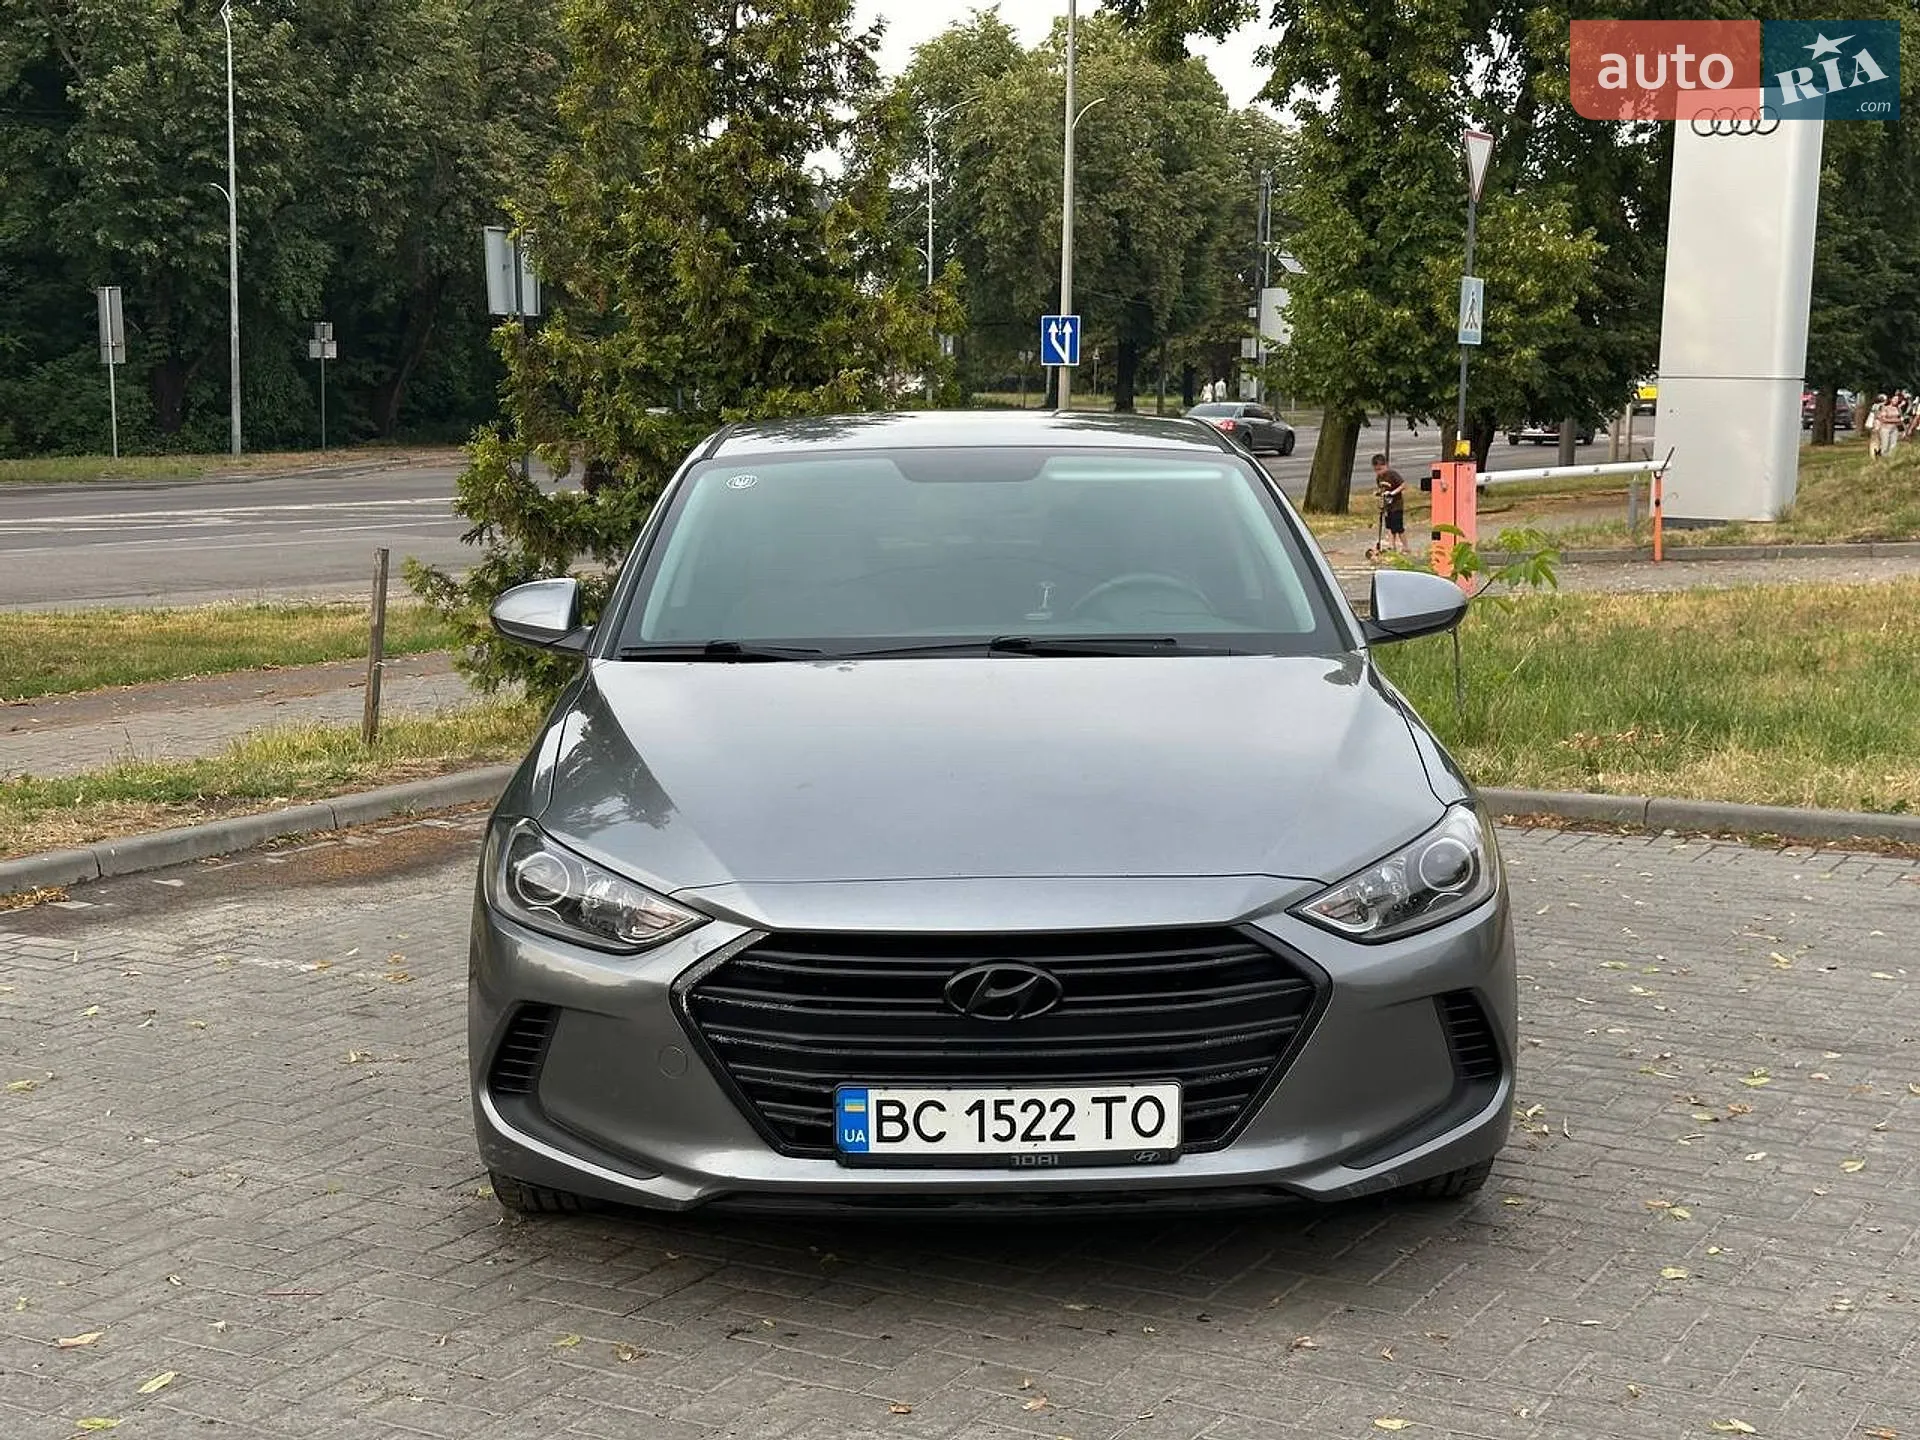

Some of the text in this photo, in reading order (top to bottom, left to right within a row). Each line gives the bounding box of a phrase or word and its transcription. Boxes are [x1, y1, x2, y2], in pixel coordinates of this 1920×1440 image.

[875, 1095, 1166, 1143] BC 1522 TO
[844, 1129, 866, 1143] UA
